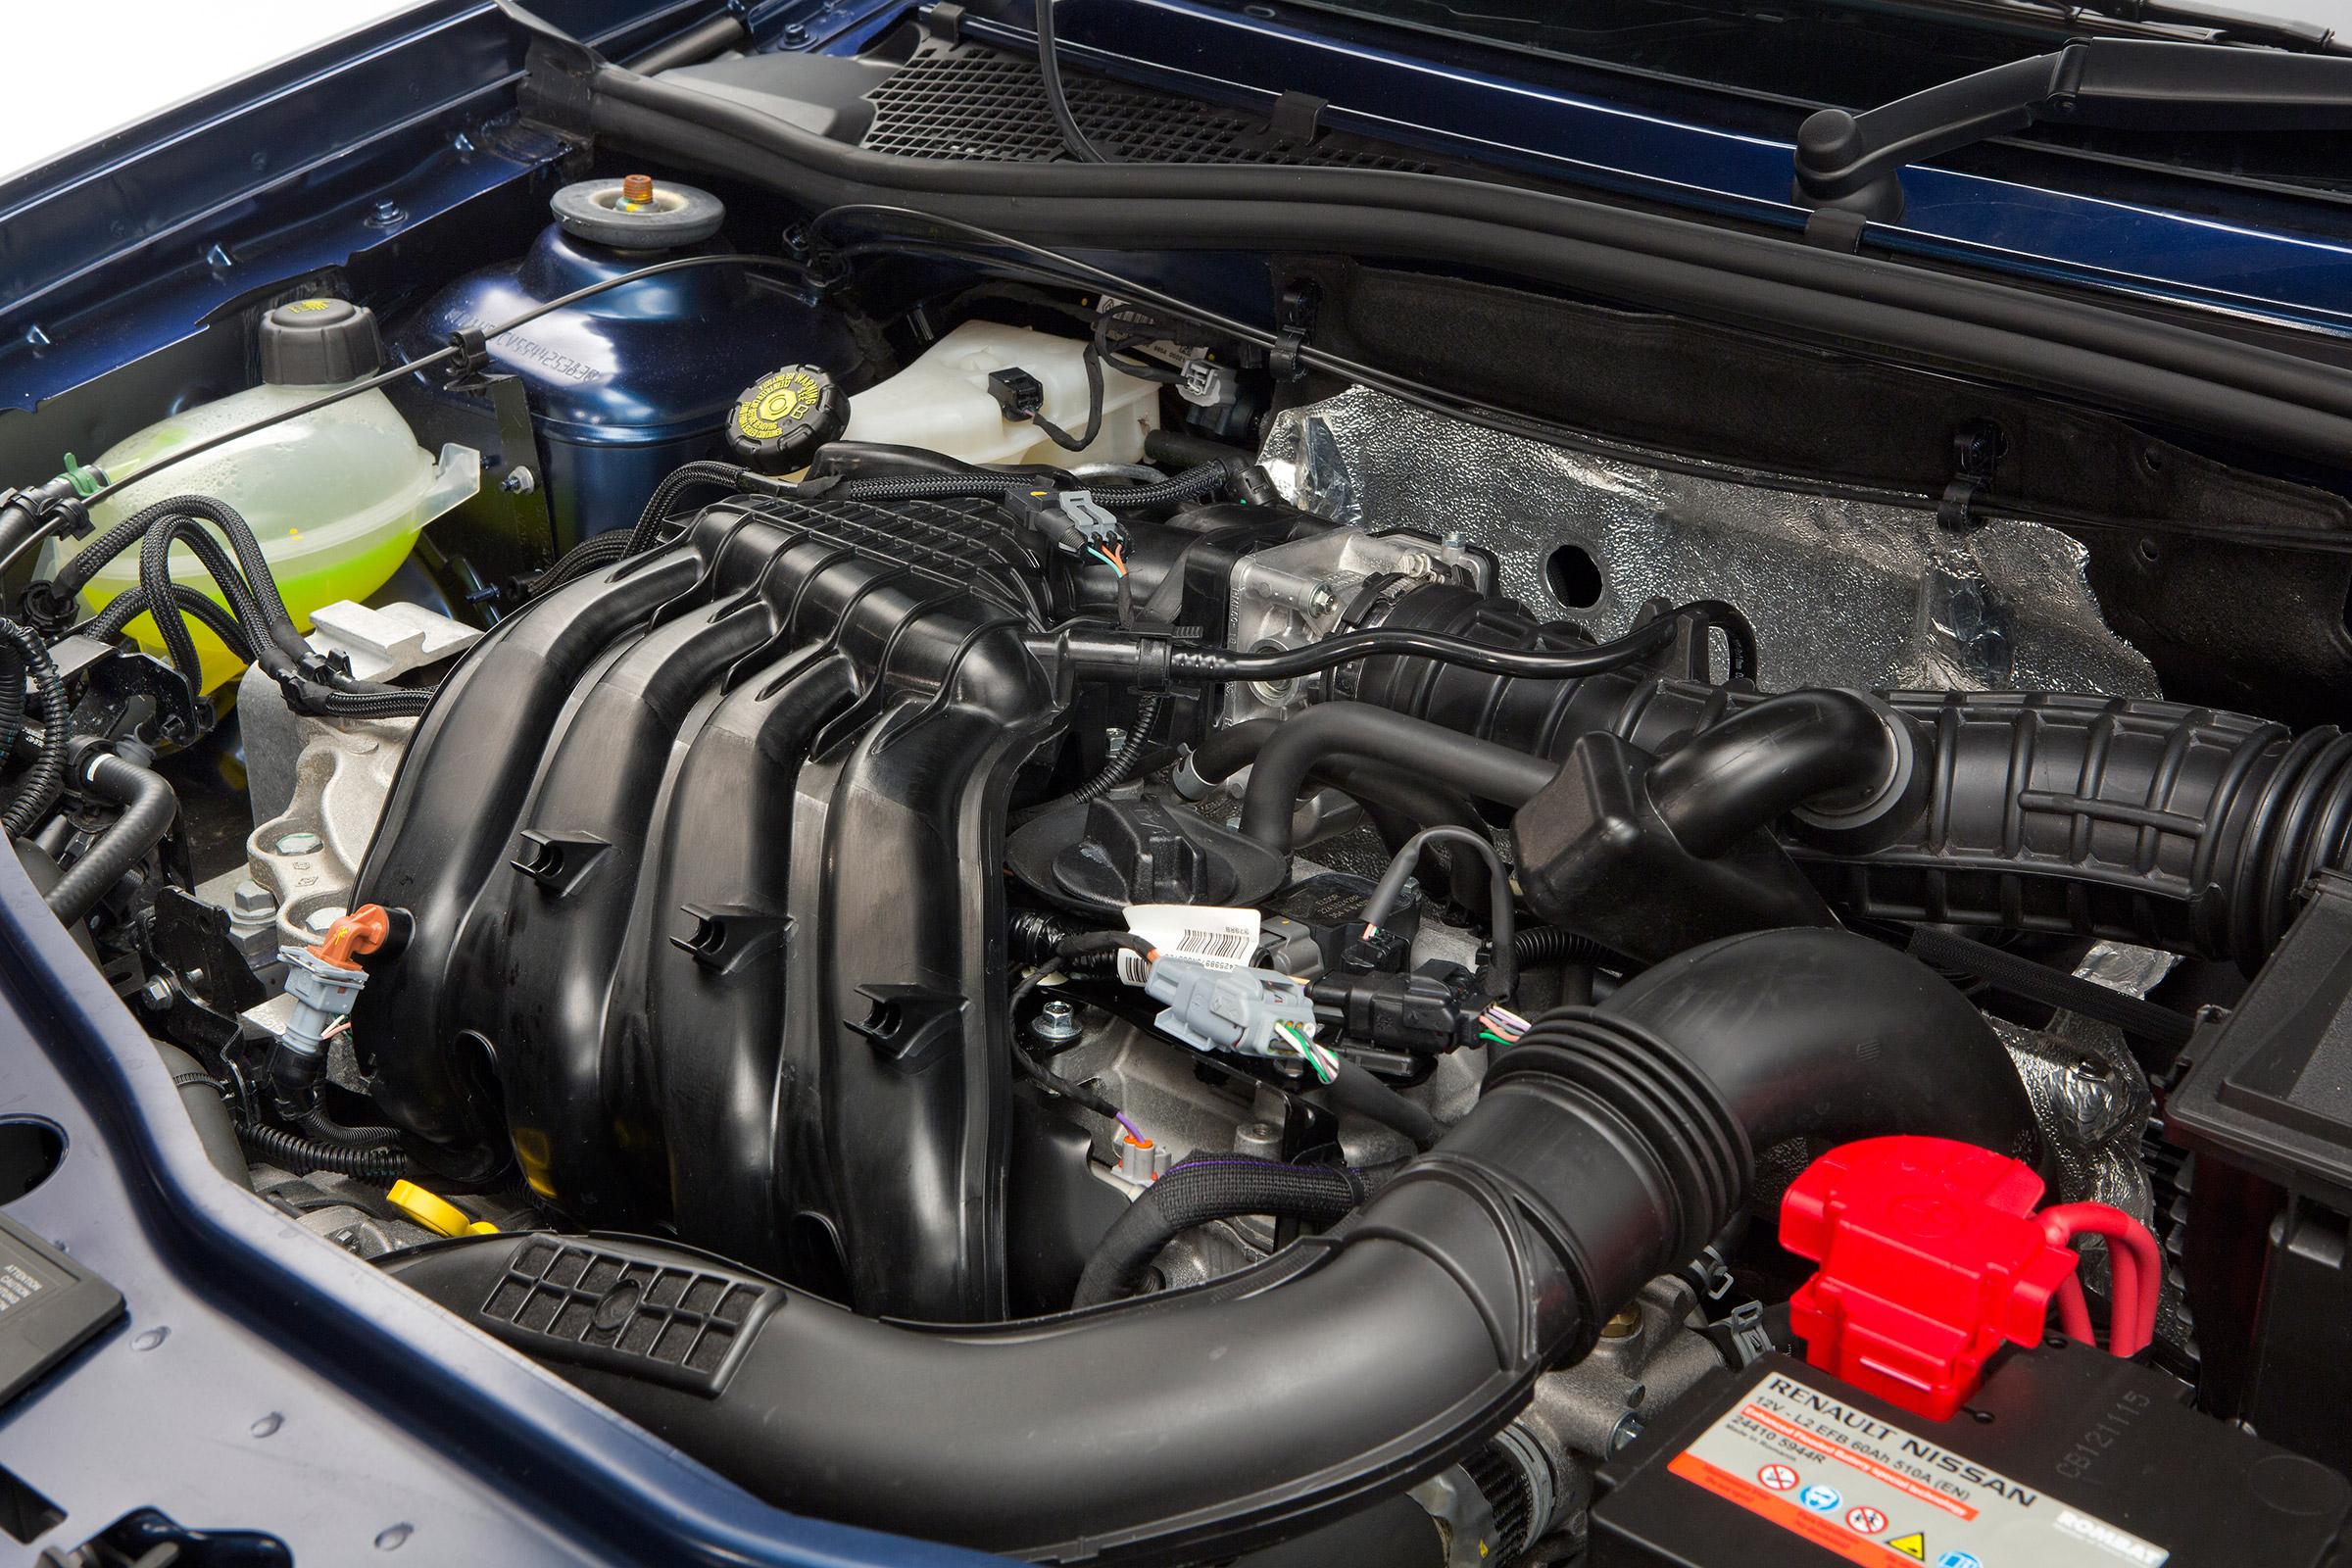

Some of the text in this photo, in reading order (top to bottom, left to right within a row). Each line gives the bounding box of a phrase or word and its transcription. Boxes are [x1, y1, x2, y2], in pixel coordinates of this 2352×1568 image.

[795, 372, 818, 405] WARNING
[0, 1275, 32, 1298] CAUTION
[4, 1264, 43, 1292] ATTENTION
[1725, 1422, 1748, 1439] Made
[1731, 1414, 1827, 1464] 24410 5944R
[1756, 1396, 1786, 1412] 12V
[1793, 1413, 1815, 1428] L2
[1815, 1423, 1849, 1445] EFB
[1851, 1440, 1890, 1463] 60Ah
[1892, 1460, 1932, 1484] 510A
[1934, 1479, 1971, 1501] (EN)
[1769, 1378, 2037, 1507] RENAULT NISSAN
[1744, 1405, 1793, 1436] Enhanced
[1793, 1429, 1836, 1454] Flooded
[1834, 1446, 1872, 1472] Battery
[1908, 1484, 1969, 1517] technology
[2056, 1510, 2163, 1565] ROMBAT
